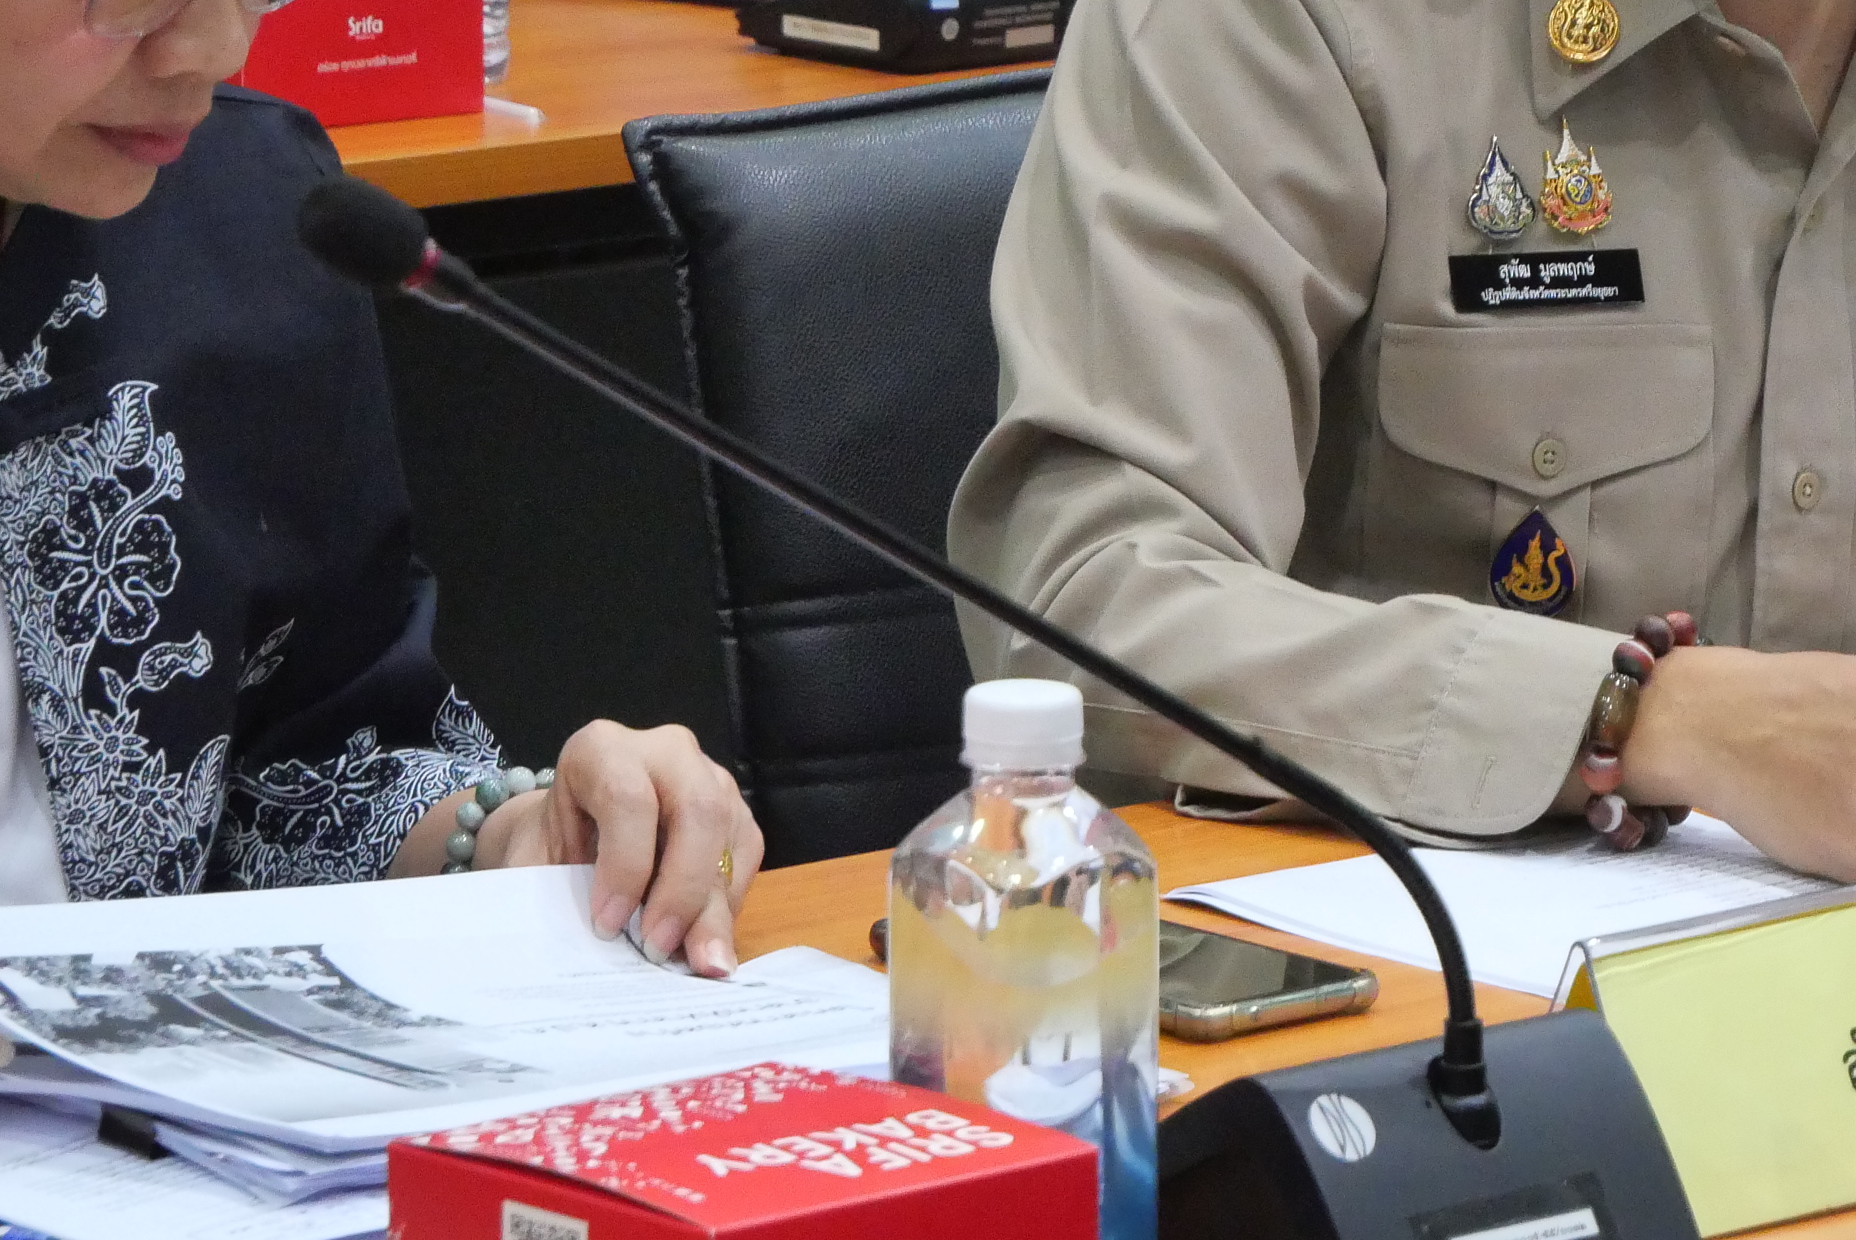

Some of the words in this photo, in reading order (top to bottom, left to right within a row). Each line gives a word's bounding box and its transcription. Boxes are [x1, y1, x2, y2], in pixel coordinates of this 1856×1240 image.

[348, 15, 384, 36] Srifa
[694, 1108, 972, 1179] BAKERY
[798, 1124, 1015, 1178] SRIFA
